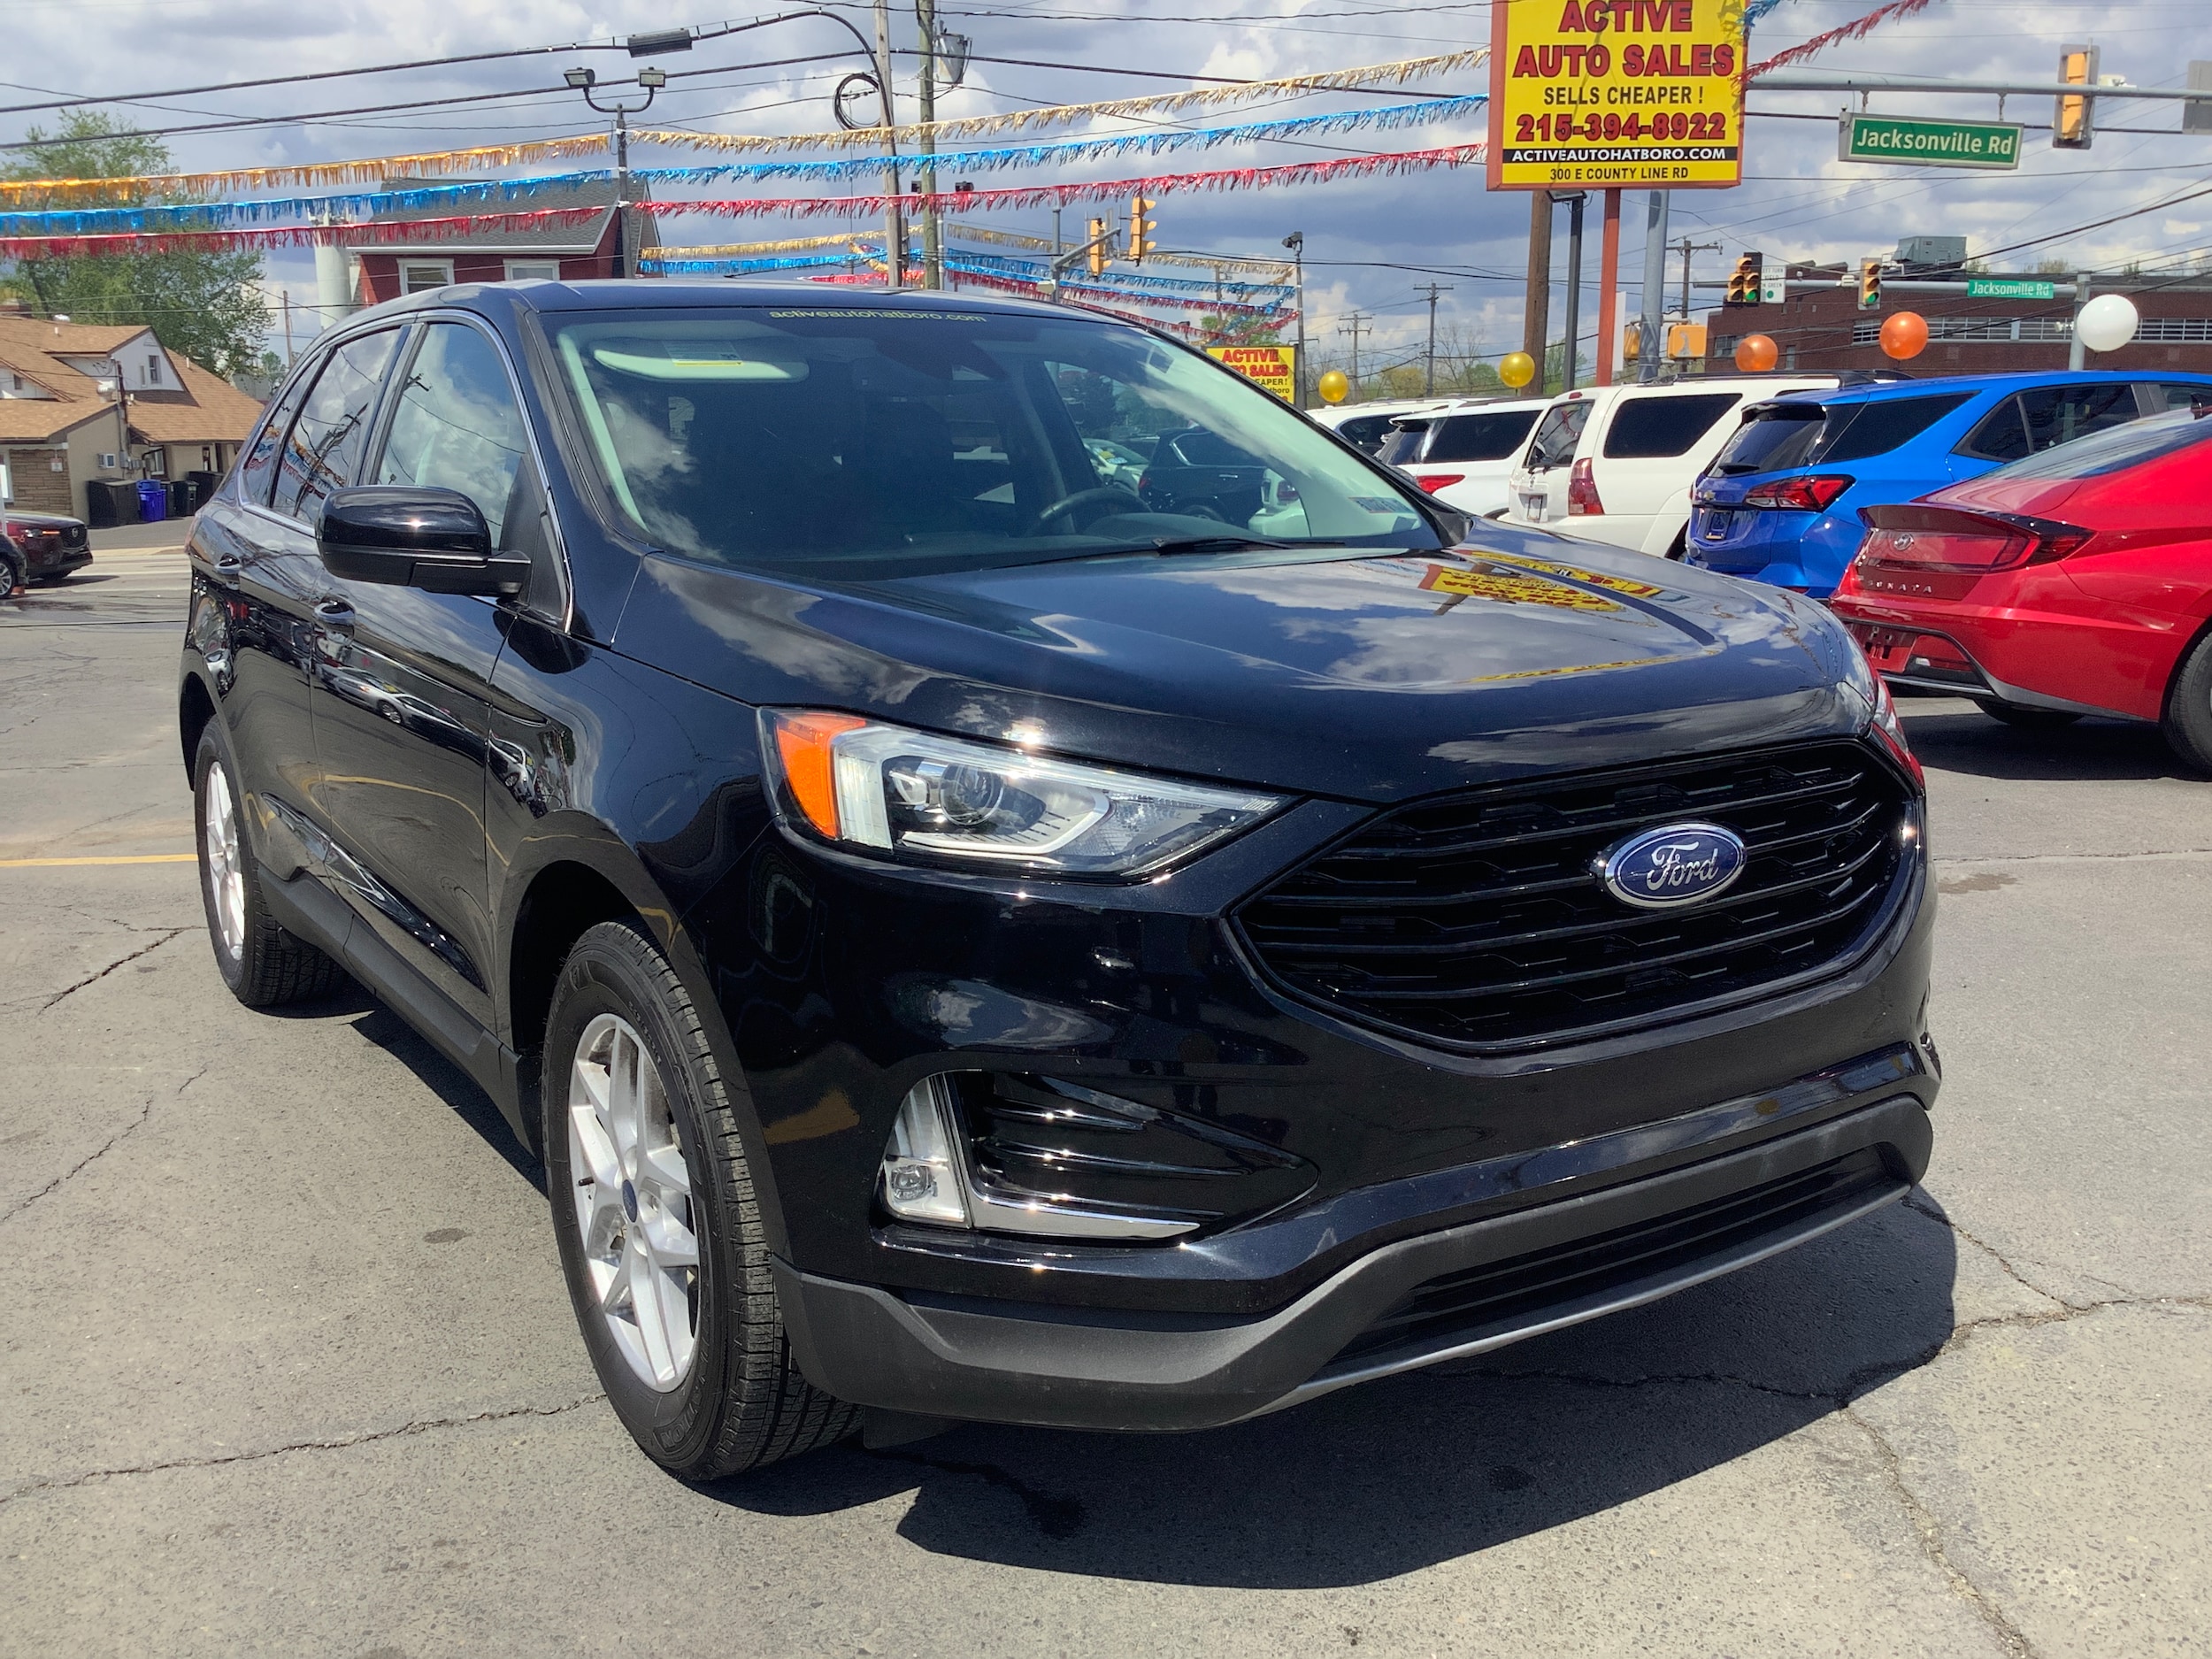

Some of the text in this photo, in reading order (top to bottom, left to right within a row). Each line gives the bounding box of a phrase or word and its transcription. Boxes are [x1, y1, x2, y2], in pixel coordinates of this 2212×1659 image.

[1558, 0, 1693, 33] ACTIVE
[1512, 44, 1734, 78] AUTO SALES
[1544, 86, 1600, 105] SELLS
[1607, 86, 1692, 104] CHEAPER
[1516, 112, 1726, 142] 215-394-8922
[1857, 128, 2013, 155] Jacksonville Rd
[1512, 148, 1725, 162] ACTIVEAUTOHATBORO.COM
[1550, 166, 1688, 180] 300 E COUNTY LINE RD
[1972, 281, 2049, 296] Jacksonville Rd
[1221, 349, 1279, 363] ACTIVE
[1249, 365, 1288, 377] SALES
[1647, 841, 1719, 890] Ford
